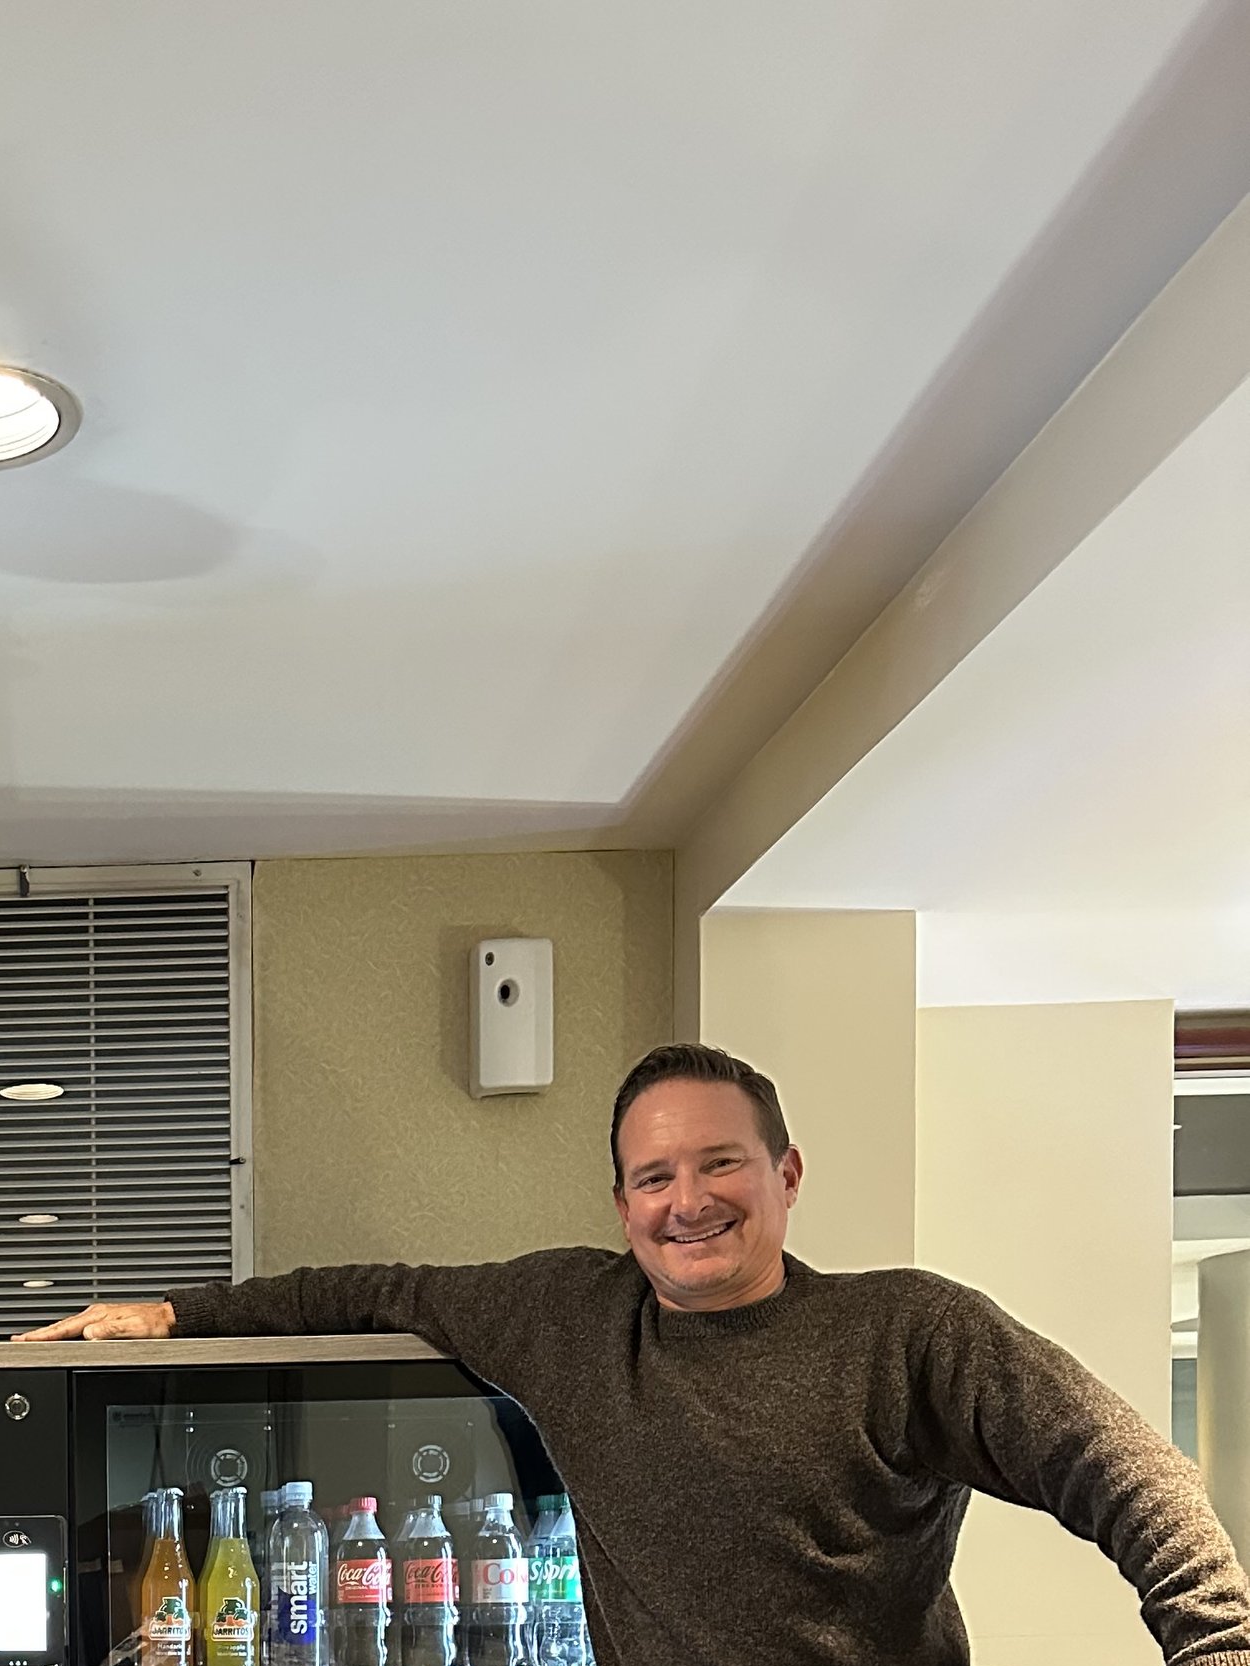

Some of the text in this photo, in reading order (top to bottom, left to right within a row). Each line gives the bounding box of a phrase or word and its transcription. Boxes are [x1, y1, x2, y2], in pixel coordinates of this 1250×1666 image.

[308, 1561, 317, 1594] water
[290, 1561, 308, 1634] smart
[213, 1626, 249, 1636] JARRITOS
[157, 1642, 184, 1650] Mandari
